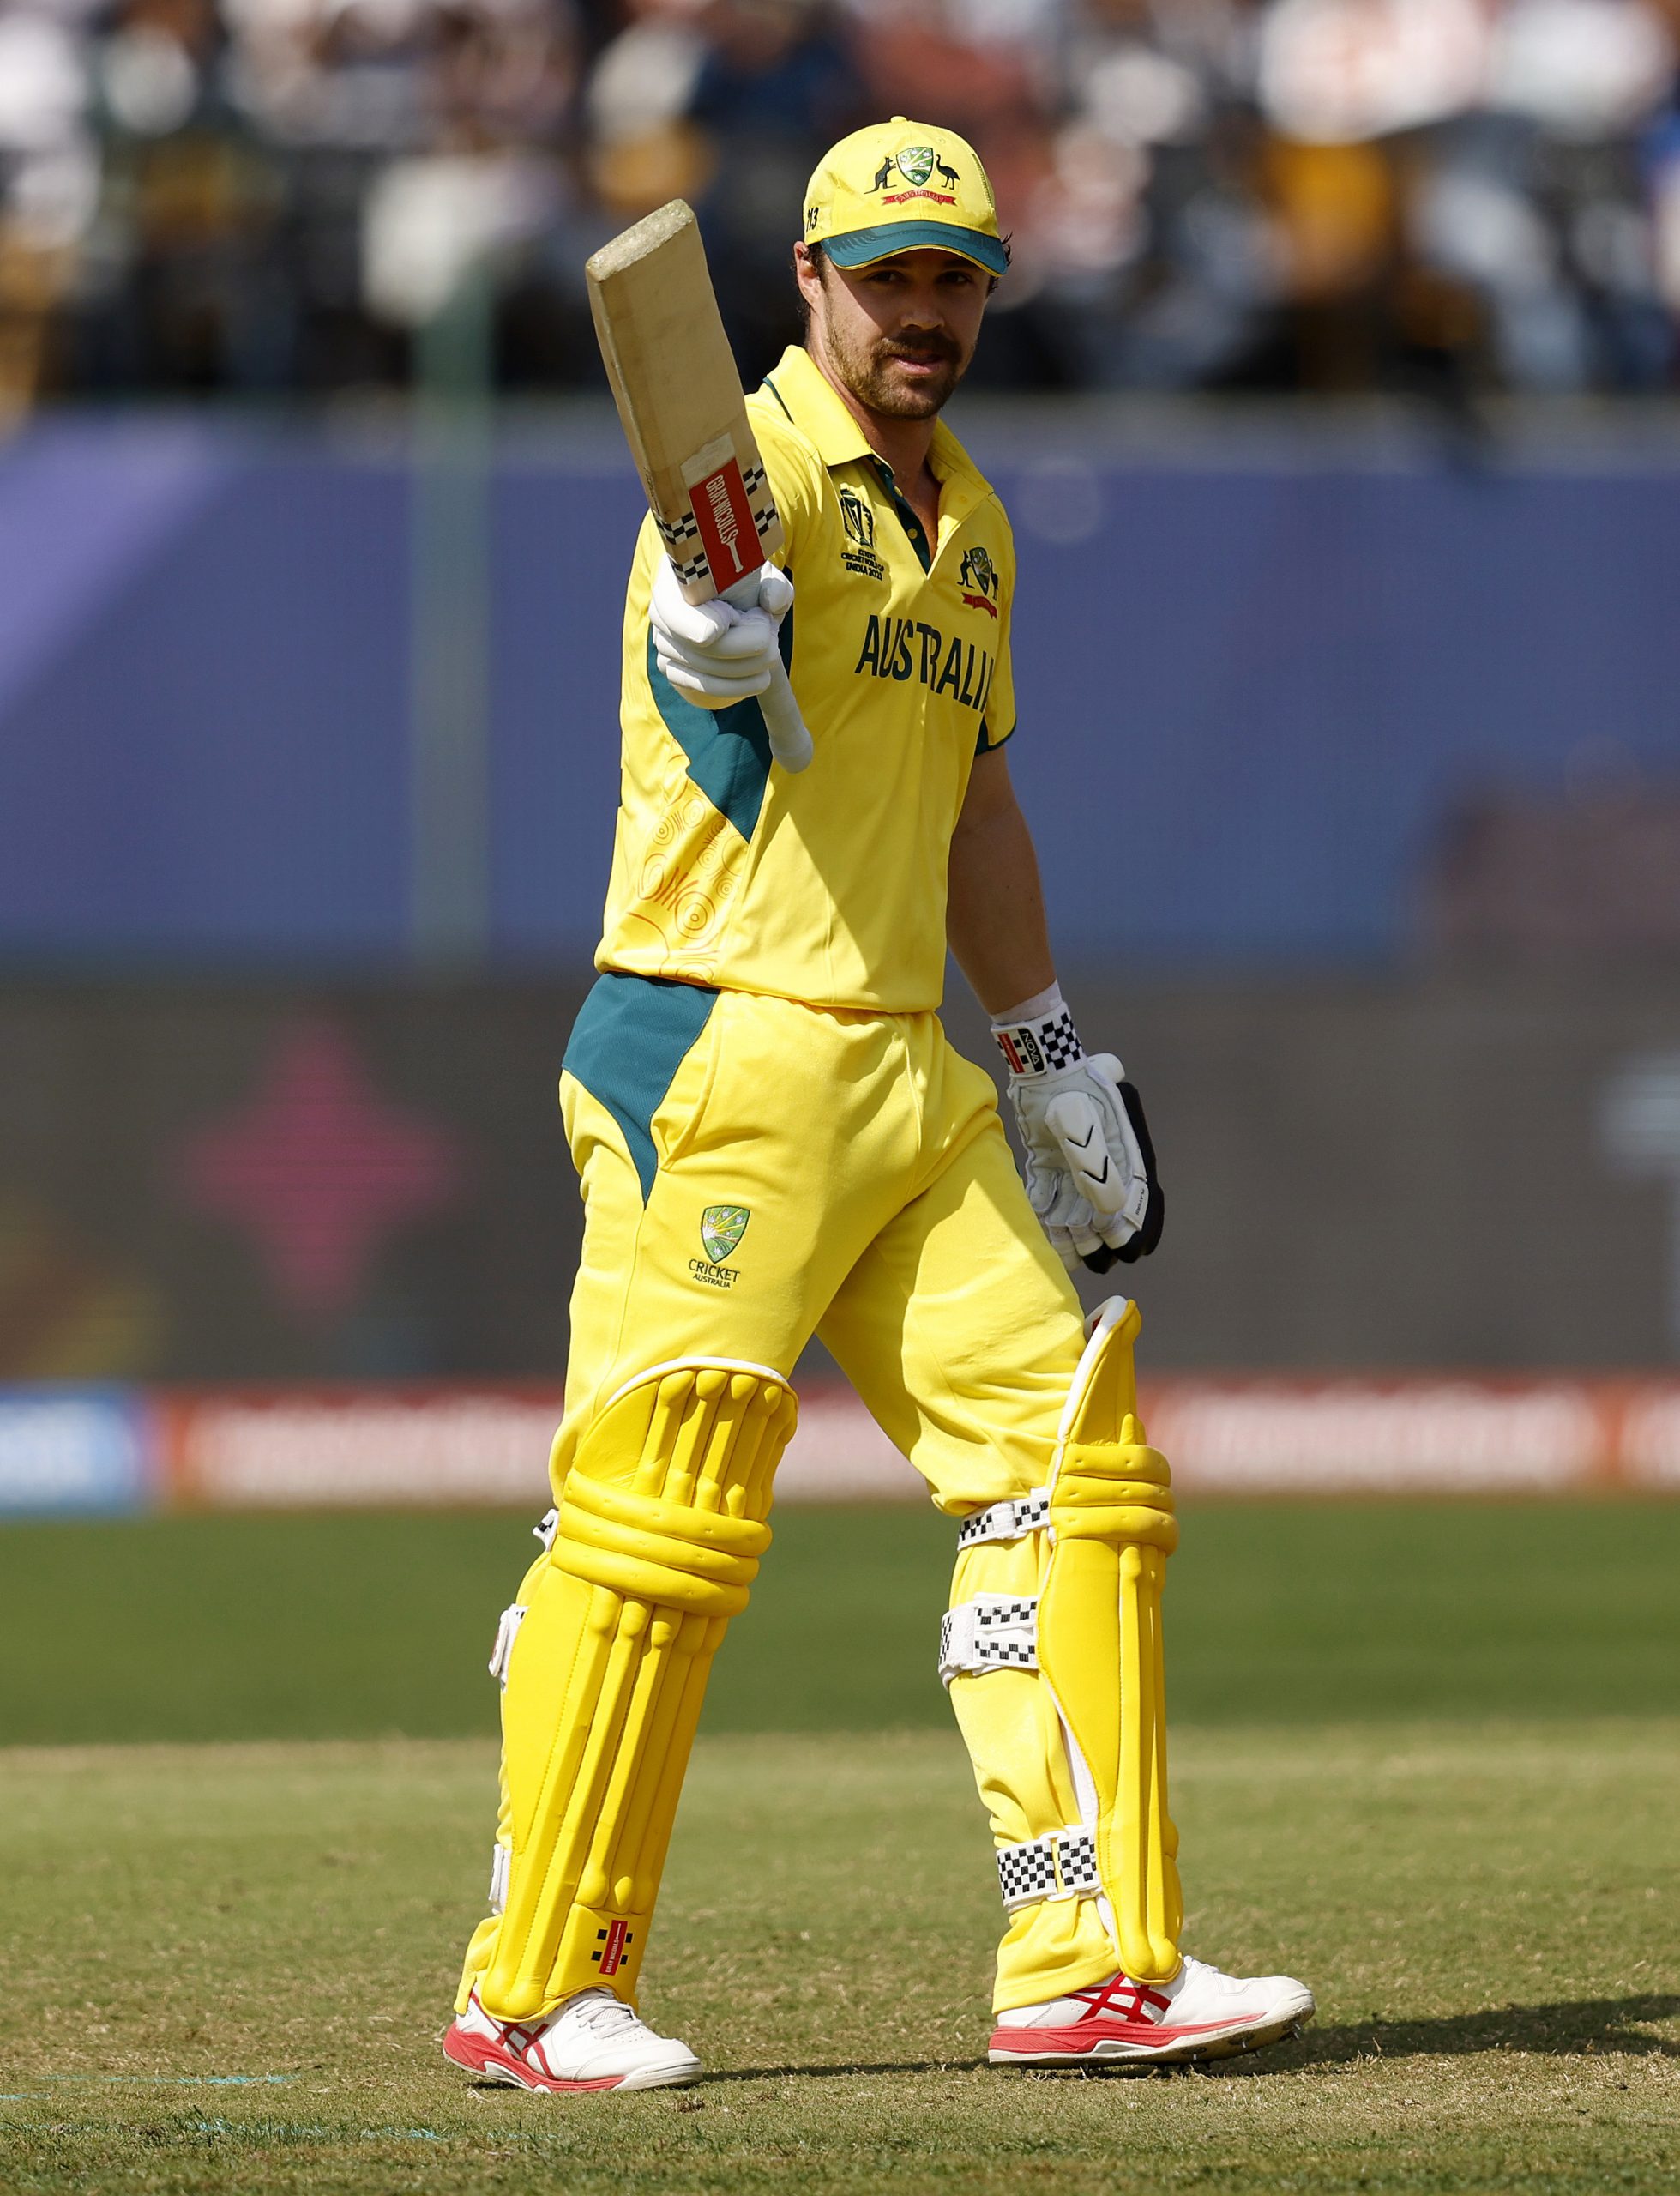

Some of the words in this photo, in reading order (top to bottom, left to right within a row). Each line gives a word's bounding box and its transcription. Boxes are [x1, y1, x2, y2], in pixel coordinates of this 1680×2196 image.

[900, 190, 940, 202] AUSTRALIA
[705, 474, 739, 544] GRAY-NICOLLS
[846, 562, 868, 576] INDIA
[1022, 1033, 1040, 1065] NOVA
[689, 1259, 740, 1282] CRICKET
[693, 1273, 732, 1288] AUSTRALIA
